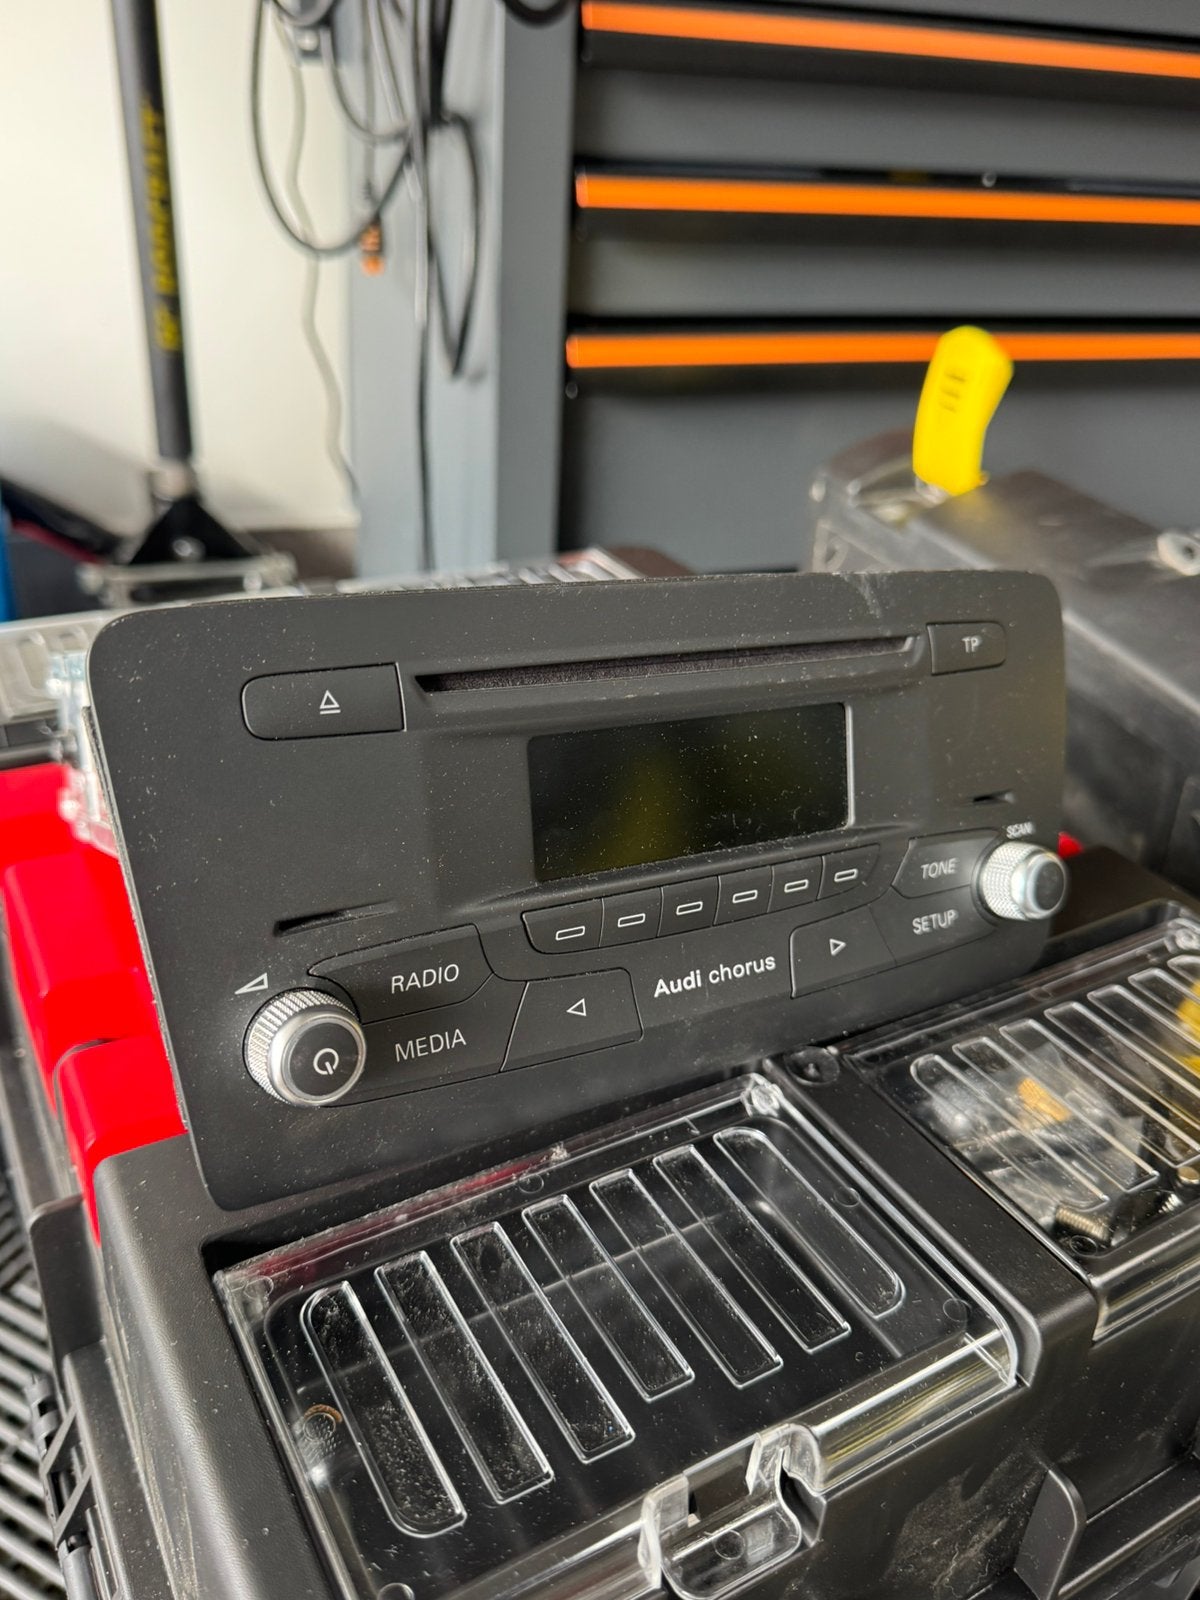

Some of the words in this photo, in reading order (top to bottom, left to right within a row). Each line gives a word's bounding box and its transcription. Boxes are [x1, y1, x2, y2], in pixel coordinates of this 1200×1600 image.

[961, 636, 981, 653] TP
[921, 858, 957, 879] TONE
[912, 909, 958, 935] SETUP
[391, 963, 460, 994] RADIO
[654, 969, 702, 998] Audi
[708, 956, 776, 984] chorus
[395, 1029, 467, 1062] MEDIA
